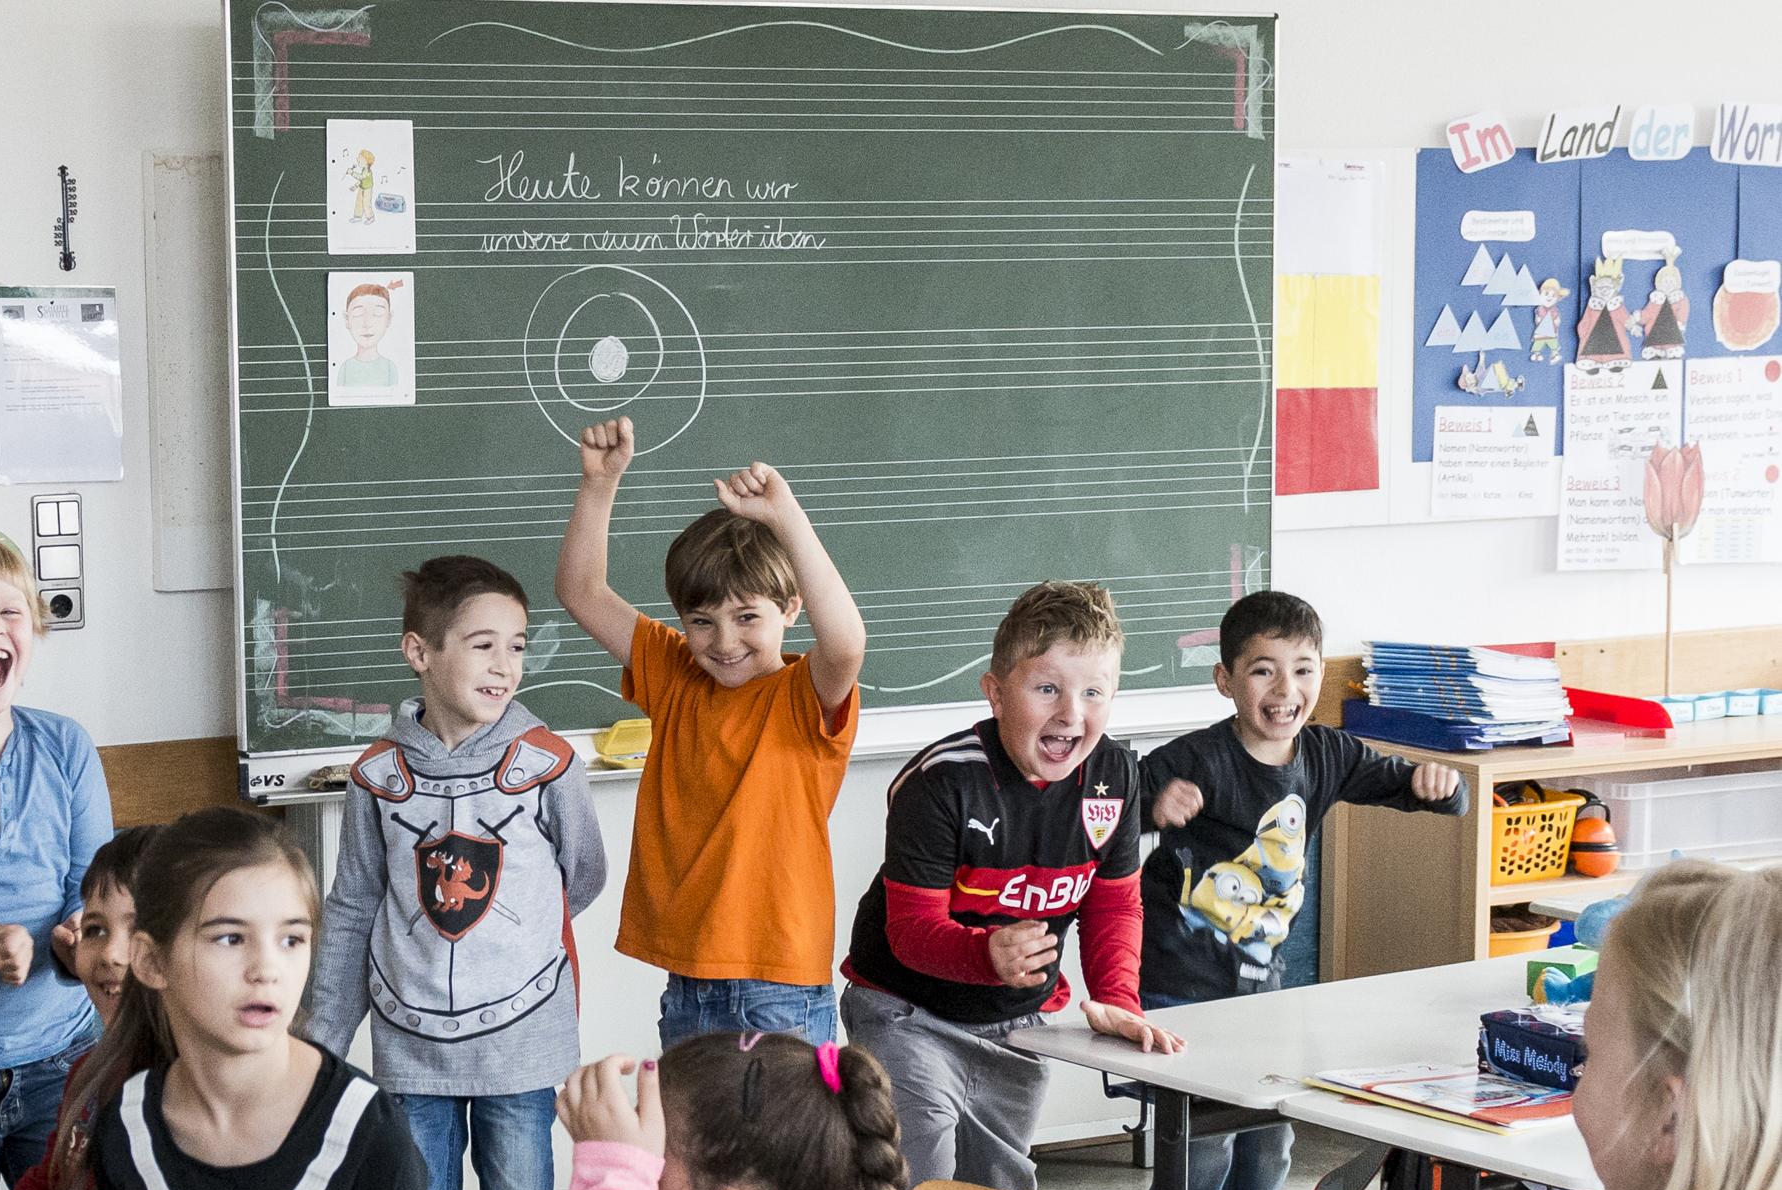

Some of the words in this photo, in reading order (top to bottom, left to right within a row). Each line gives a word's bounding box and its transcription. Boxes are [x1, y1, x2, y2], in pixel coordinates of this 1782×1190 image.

[1448, 121, 1515, 171] Im
[1540, 103, 1621, 162] Land
[1633, 108, 1690, 158] der
[476, 150, 600, 201] Heute
[619, 153, 734, 198] können
[747, 180, 798, 199] wir
[481, 229, 572, 252] unsere
[583, 230, 668, 252] neuen
[669, 213, 753, 250] Wörter
[1570, 374, 1613, 390] Beweis
[1618, 373, 1625, 388] 2
[1690, 370, 1732, 385] Beweis
[1738, 368, 1742, 382] 1
[1439, 417, 1483, 432] Beweis
[1488, 417, 1492, 432] 1
[1566, 476, 1609, 491] Beweis
[1614, 476, 1620, 491] 3
[263, 774, 285, 787] VS
[1494, 1037, 1521, 1064] Miss
[1523, 1045, 1568, 1083] Melody
